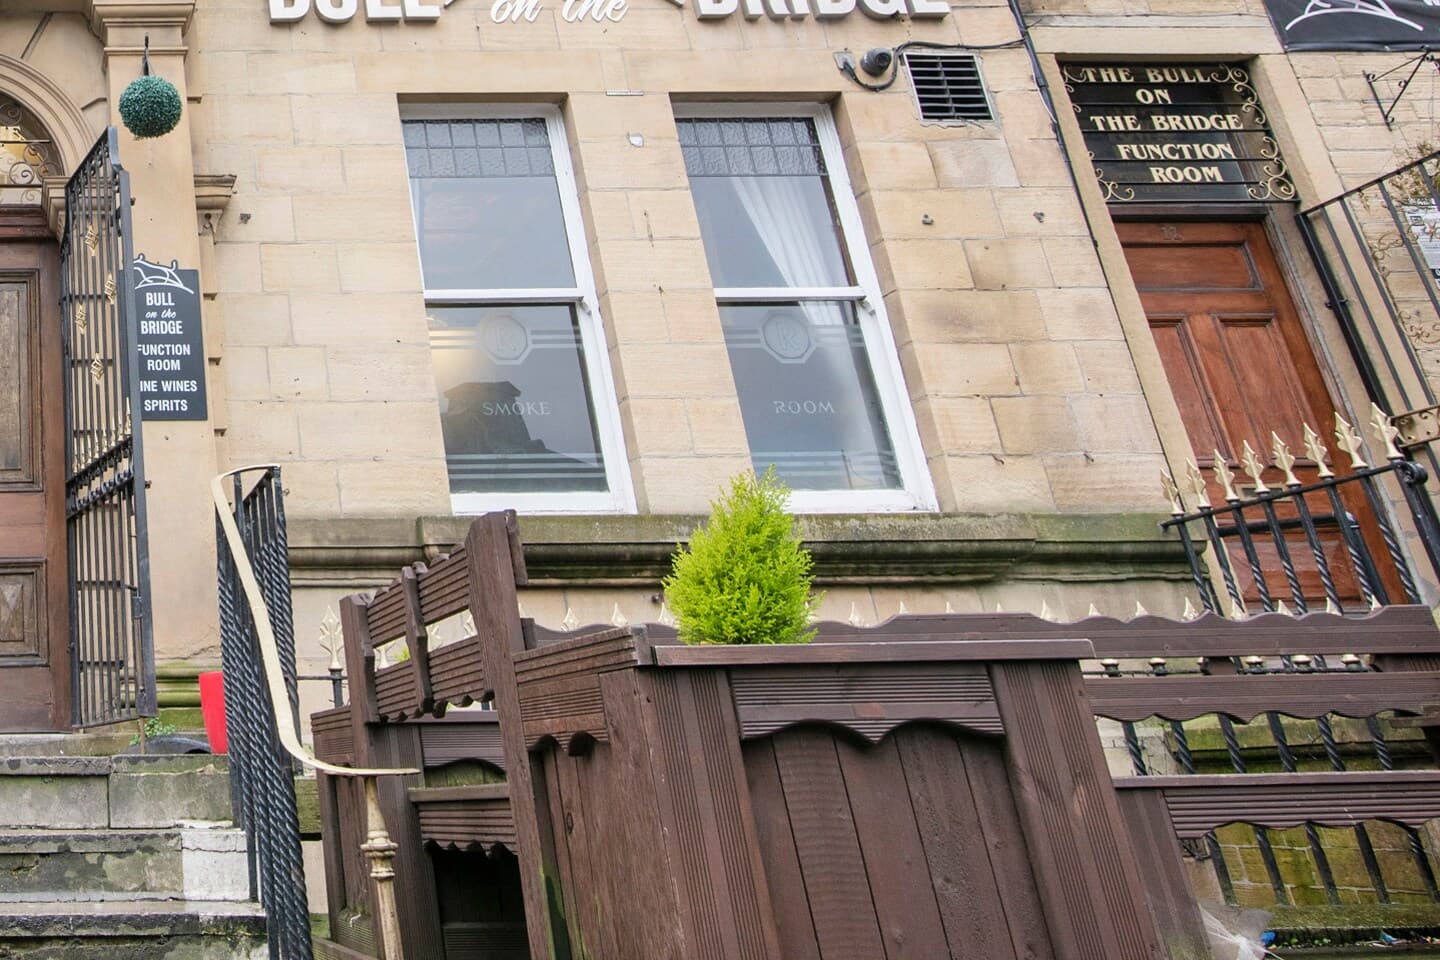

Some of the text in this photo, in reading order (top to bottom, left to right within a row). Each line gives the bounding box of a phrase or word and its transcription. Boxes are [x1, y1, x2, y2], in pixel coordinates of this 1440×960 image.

[1082, 67, 1211, 83] THE BULL
[1135, 88, 1173, 105] ON
[1090, 114, 1244, 131] THE BRIDGE
[1116, 143, 1237, 160] FUNCTION
[1150, 166, 1224, 183] ROOM
[145, 292, 175, 306] BULL
[145, 308, 176, 319] on the
[140, 320, 183, 335] BRIDGE
[147, 359, 181, 371] ROOM
[139, 380, 197, 392] INE WINES
[144, 399, 188, 412] SPIRITS
[482, 401, 552, 415] SMOKE
[773, 400, 835, 414] ROOM
